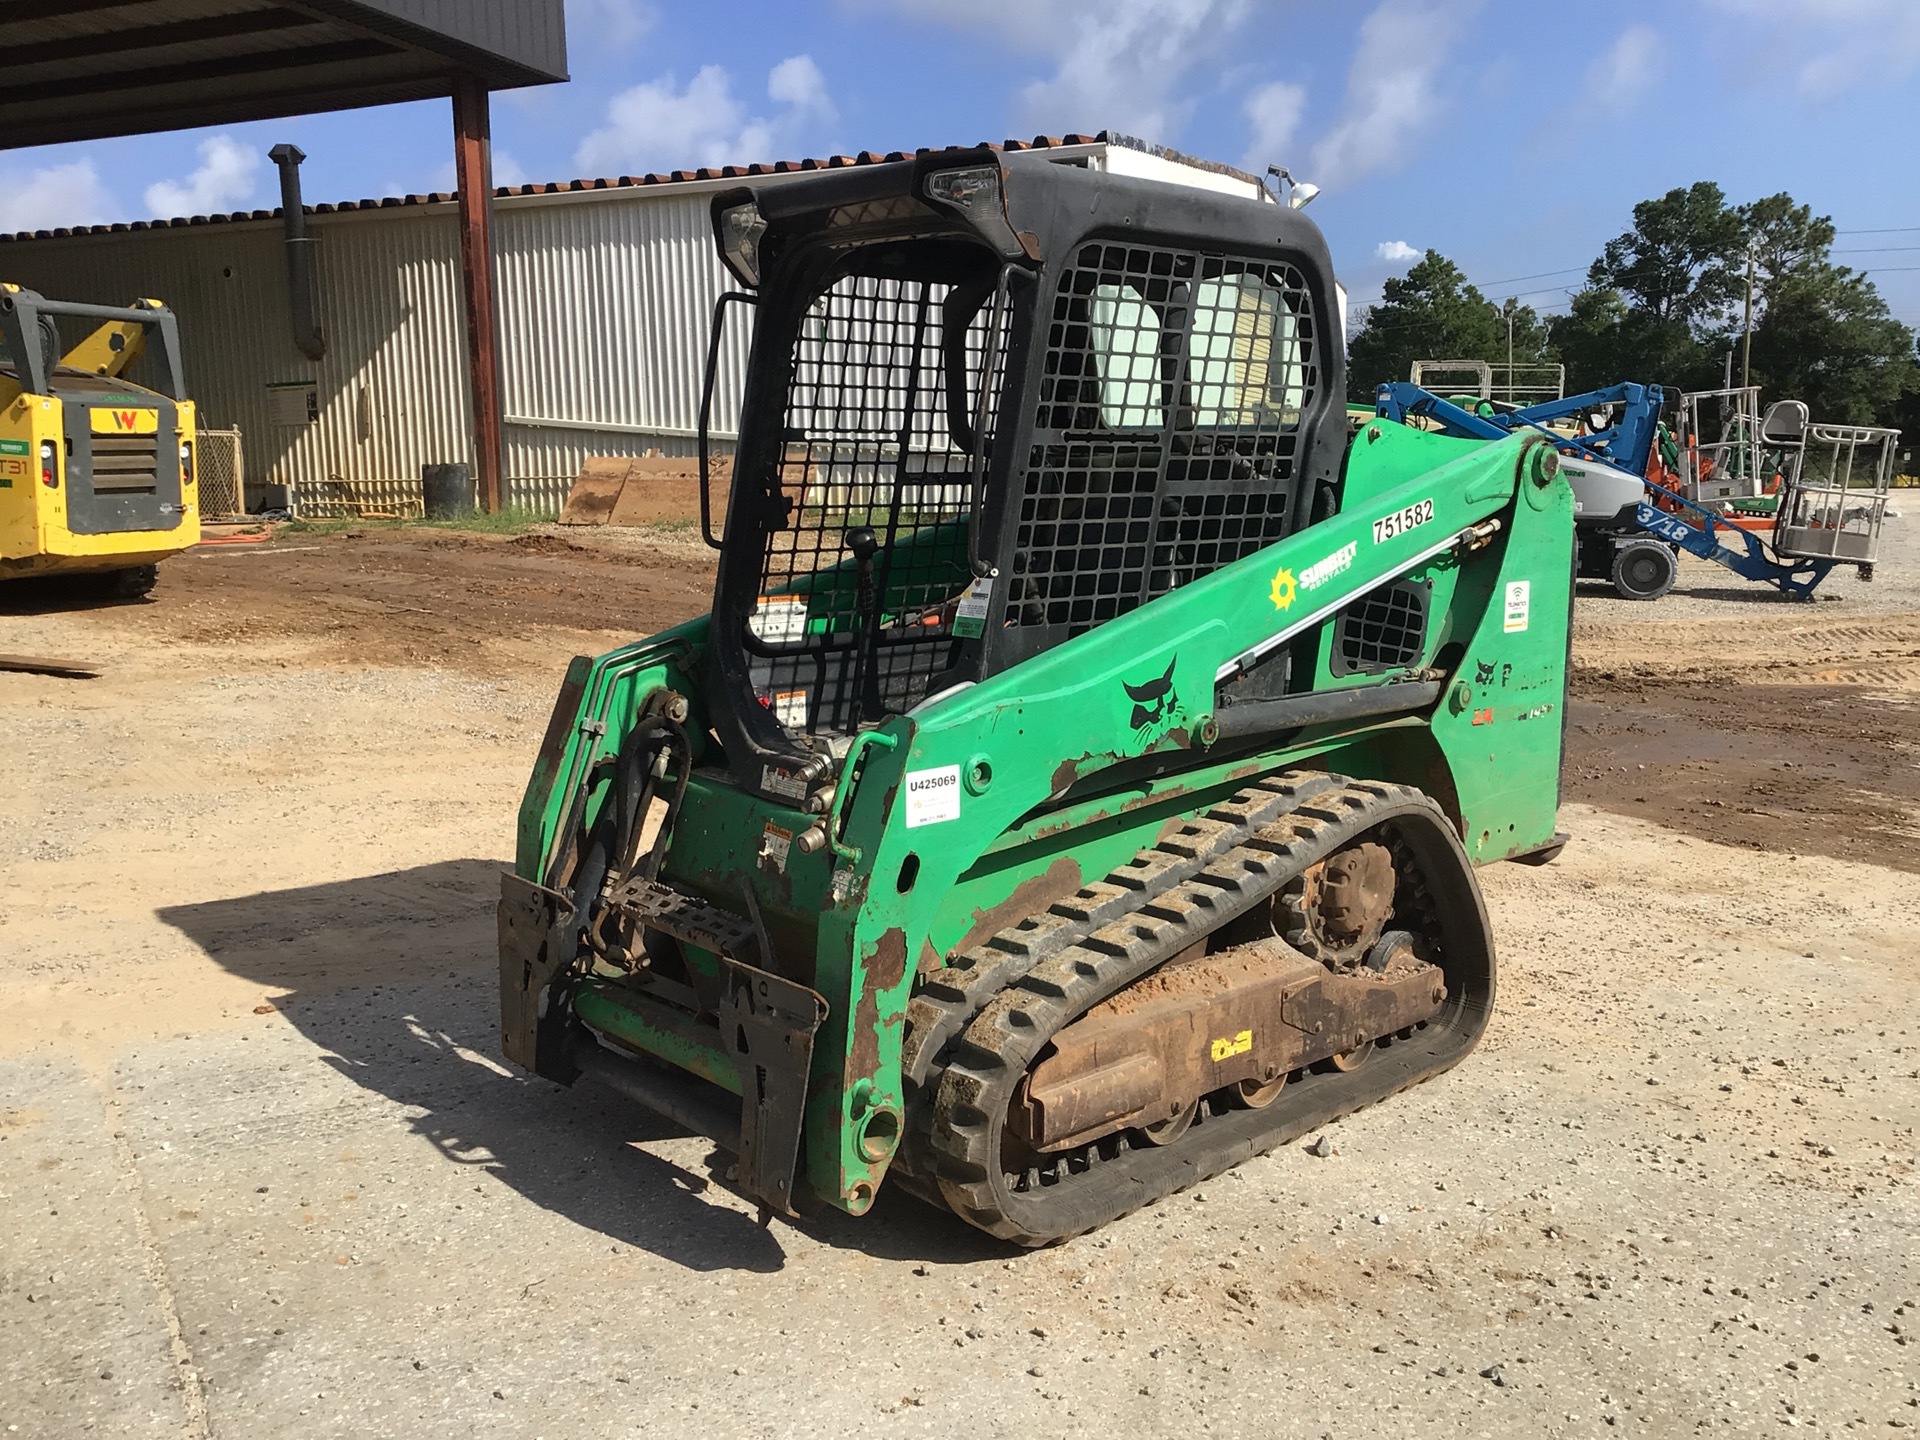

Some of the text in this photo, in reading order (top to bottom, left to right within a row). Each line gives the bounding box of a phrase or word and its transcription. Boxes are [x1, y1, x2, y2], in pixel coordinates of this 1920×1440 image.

[112, 410, 137, 430] W
[1374, 500, 1433, 543] 751582
[1637, 505, 1688, 541] 3/18
[1299, 540, 1357, 589] SUNBELT
[1309, 562, 1352, 591] RENTALS
[910, 774, 956, 792] U425069
